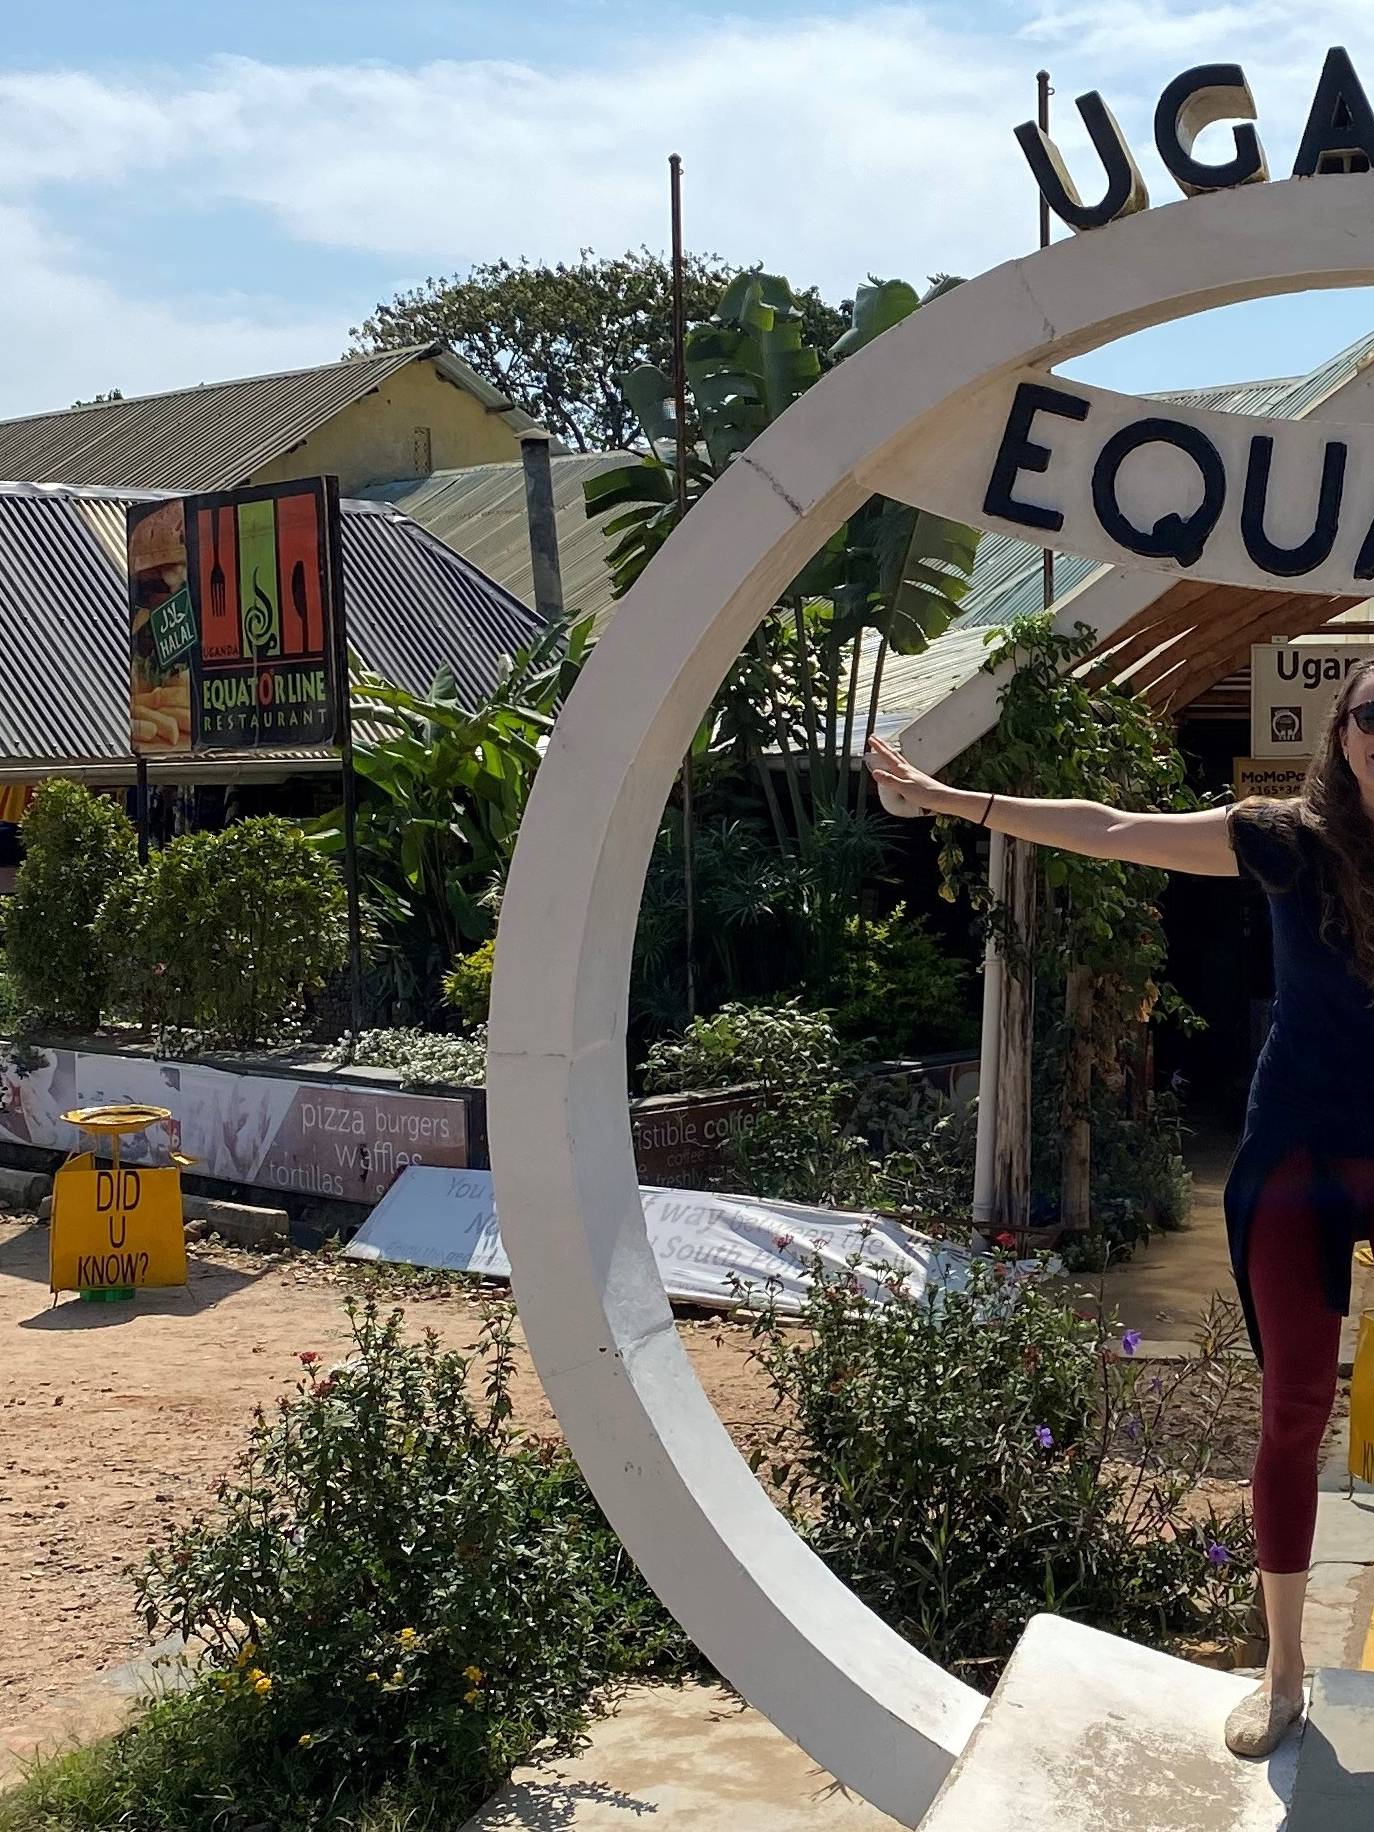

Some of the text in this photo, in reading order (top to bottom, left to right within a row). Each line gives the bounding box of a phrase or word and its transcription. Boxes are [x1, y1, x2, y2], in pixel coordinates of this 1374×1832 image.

[159, 622, 194, 659] HALAL
[203, 708, 327, 732] RESTAURANT
[301, 1097, 450, 1142] pizza burgers
[334, 1140, 423, 1176] waffles
[96, 1170, 141, 1212] DID
[269, 1160, 344, 1197] tortillas
[446, 1176, 486, 1200] You
[109, 1215, 126, 1249] U
[77, 1251, 149, 1287] KNOW?
[659, 1235, 742, 1267] South
